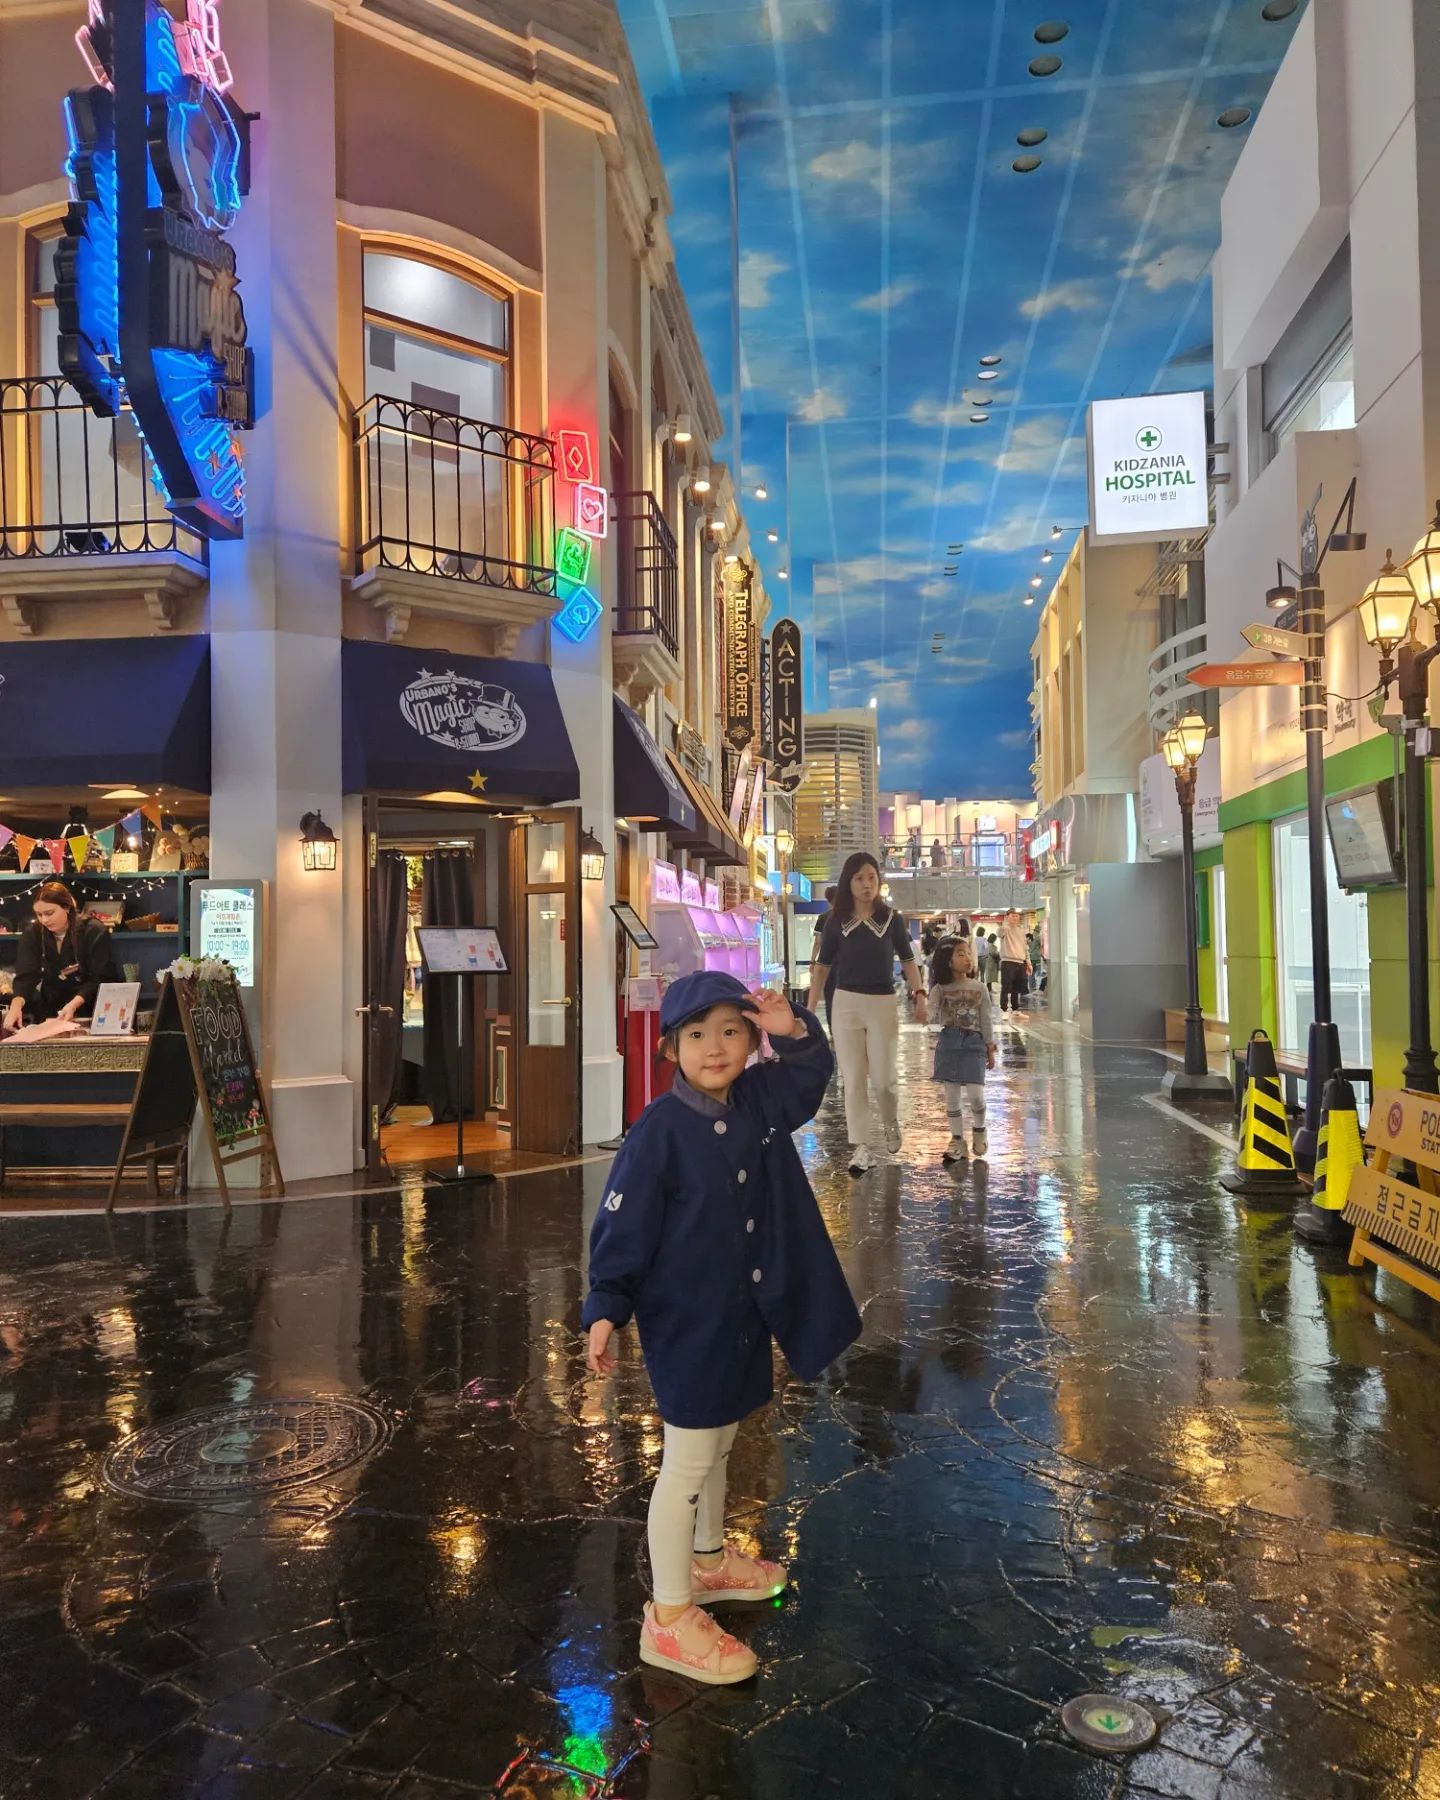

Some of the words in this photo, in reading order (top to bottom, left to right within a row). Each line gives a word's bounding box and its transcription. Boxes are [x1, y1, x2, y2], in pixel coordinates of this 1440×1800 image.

[1114, 455, 1186, 473] KIDZANIA
[1105, 470, 1196, 492] HOSPITAL
[1122, 493, 1156, 504] 키자니아
[1160, 491, 1178, 501] 병원
[735, 590, 749, 668] TELEGRAPH
[405, 683, 458, 703] URBANO'S
[735, 672, 749, 718] OFFICE
[777, 638, 798, 758] ACTING
[413, 699, 472, 736] Magic
[207, 940, 224, 952] 10:00
[1377, 1184, 1440, 1241] 접근금지
